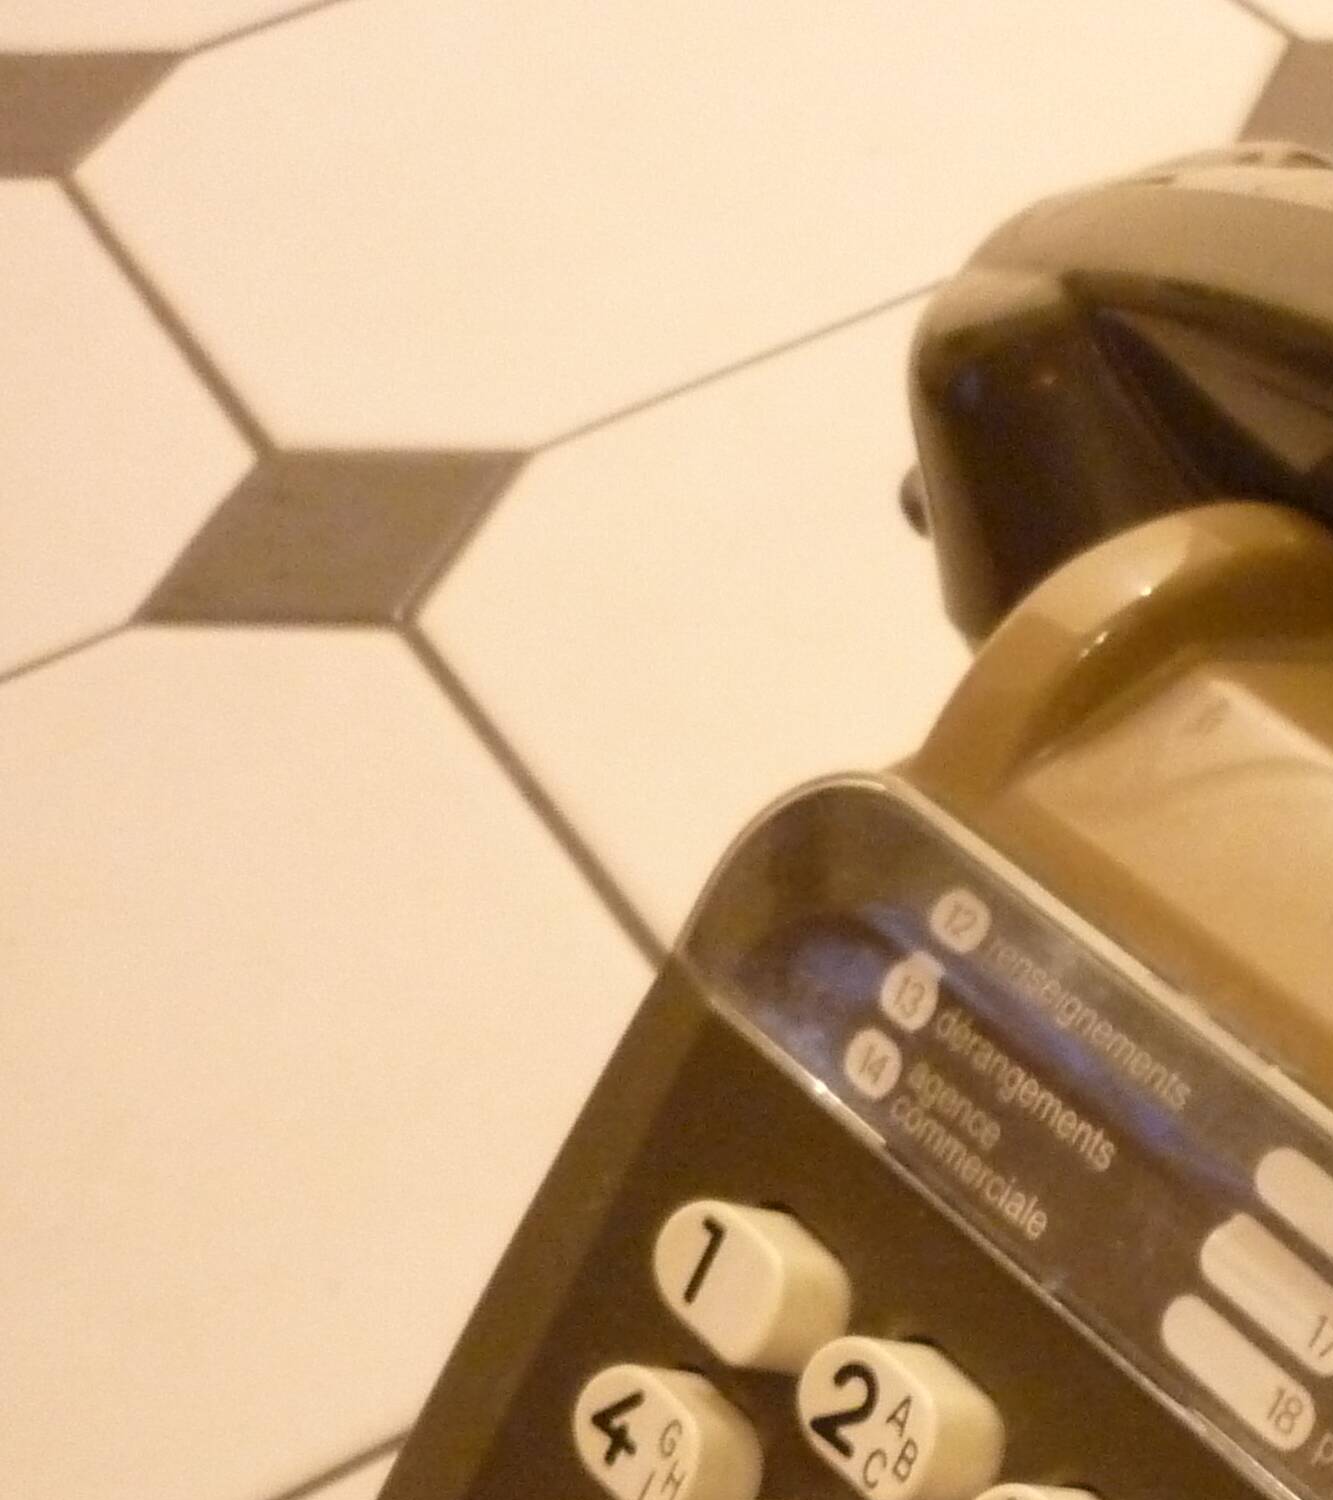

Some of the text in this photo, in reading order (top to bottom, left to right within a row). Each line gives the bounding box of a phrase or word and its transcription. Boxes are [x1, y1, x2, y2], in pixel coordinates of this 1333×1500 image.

[990, 936, 1192, 1112] renseignements
[909, 1060, 1001, 1150] agence
[891, 1094, 1049, 1241] commerciale
[683, 1215, 727, 1304] 1
[590, 1390, 646, 1466] 4
[809, 1362, 880, 1459] 2
[1265, 1386, 1302, 1435] 18
